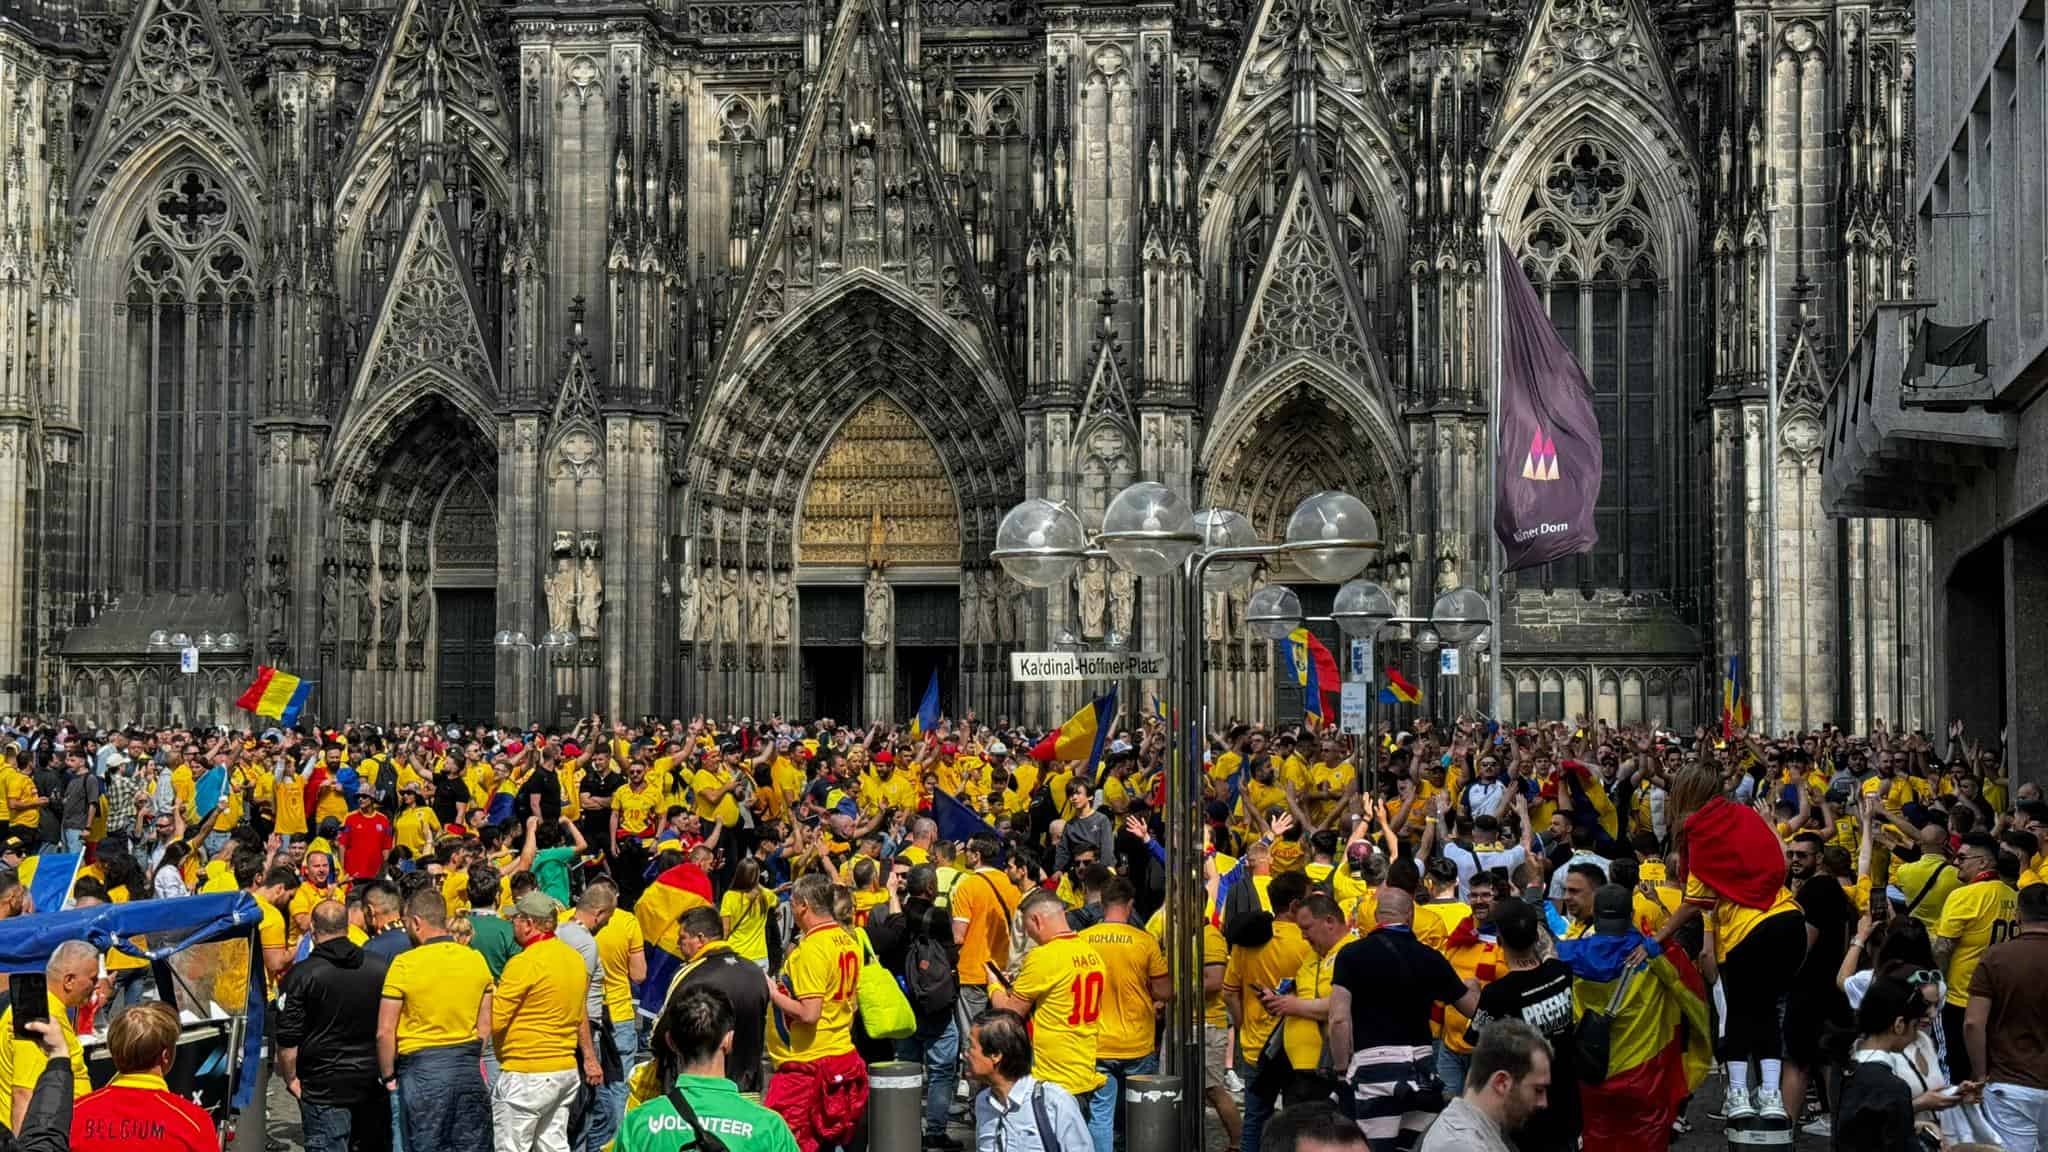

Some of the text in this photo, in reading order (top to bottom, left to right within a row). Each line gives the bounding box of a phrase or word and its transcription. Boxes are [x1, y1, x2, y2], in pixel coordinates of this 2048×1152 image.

[1541, 523, 1569, 534] Dom
[1020, 656, 1160, 676] Kardinal-Höffner-Platz
[834, 950, 858, 1001] 10
[1067, 971, 1104, 1025] 10
[84, 1118, 165, 1141] BELGIUM
